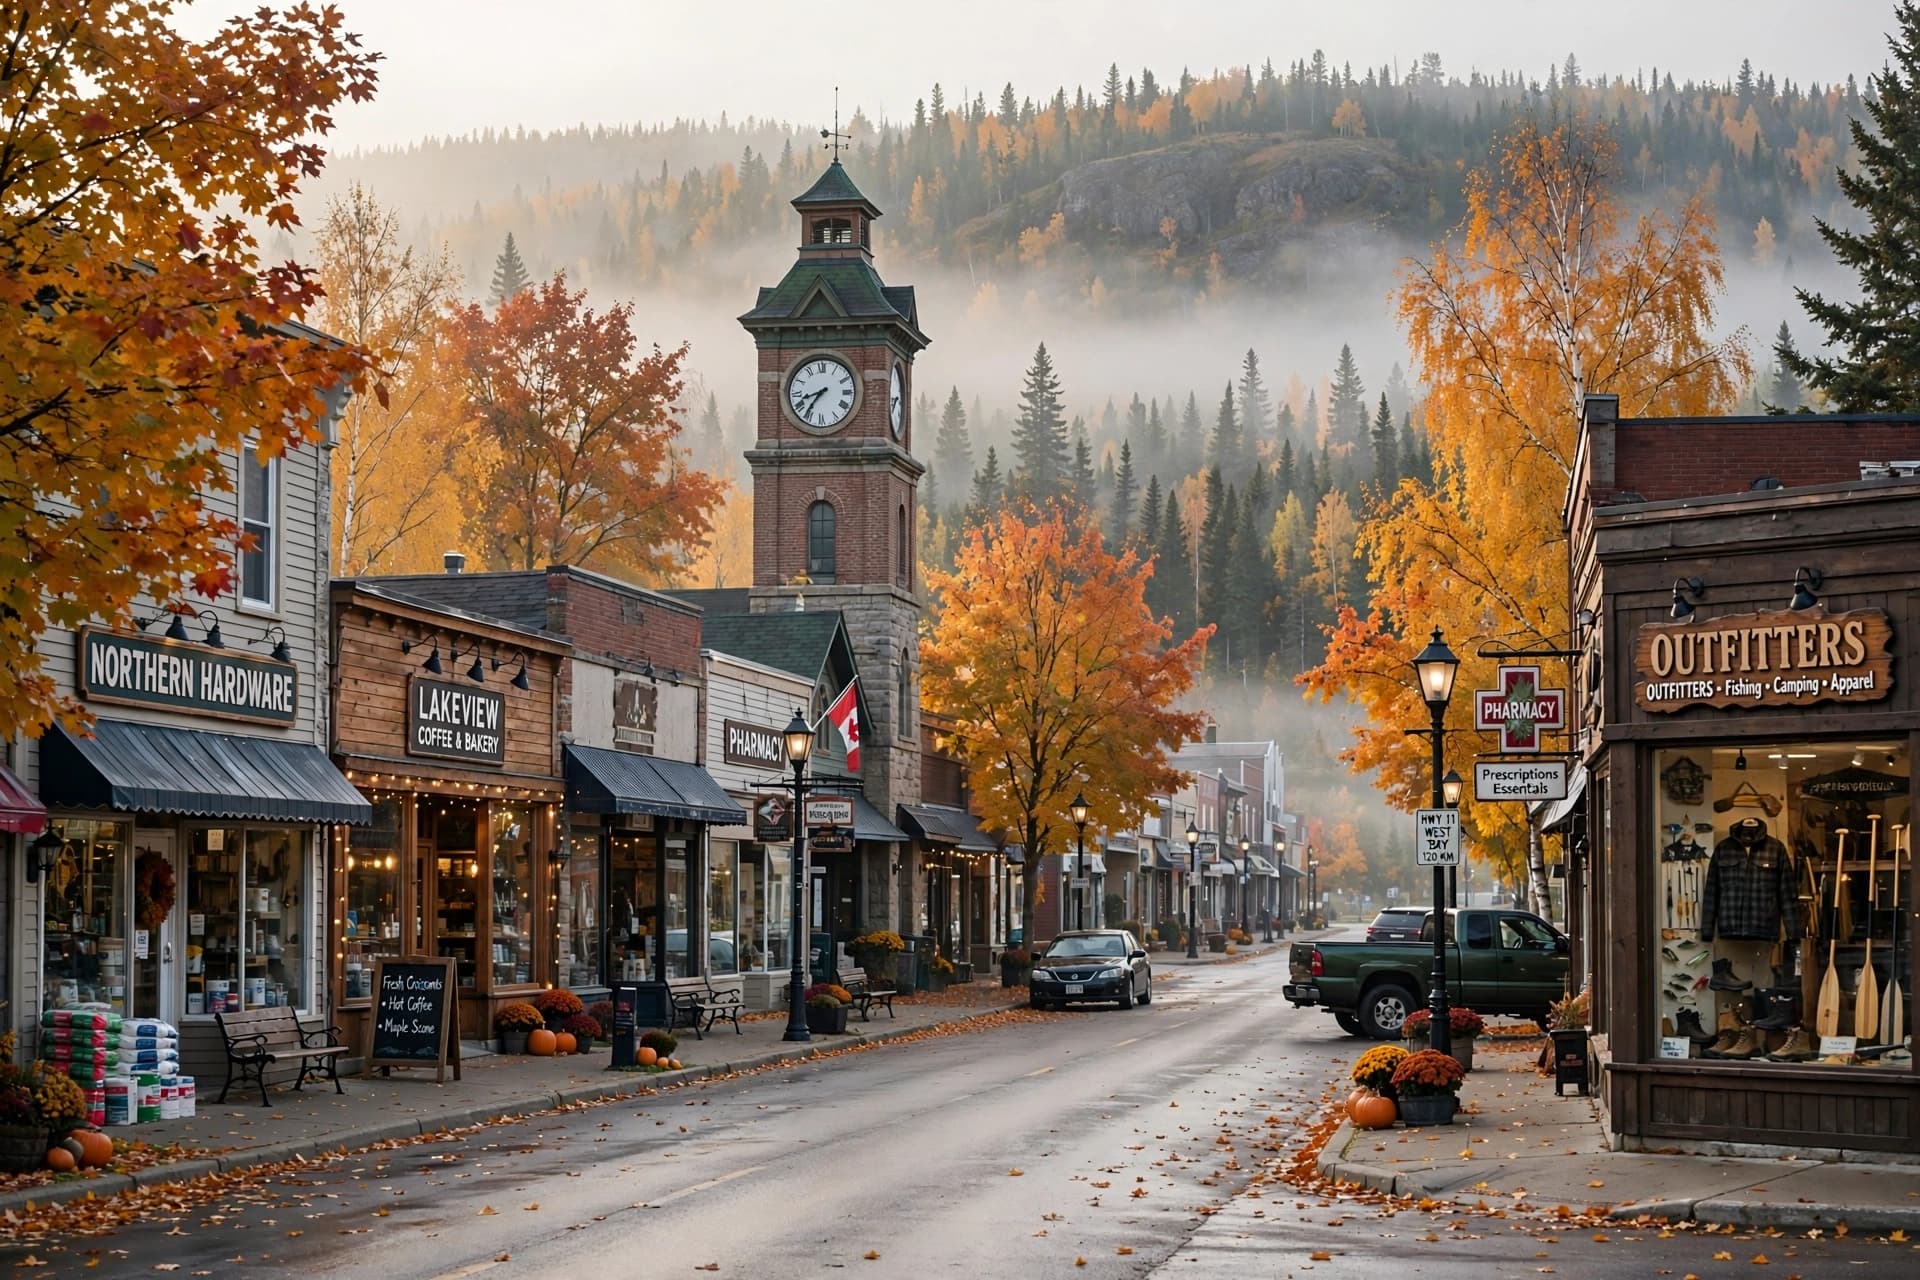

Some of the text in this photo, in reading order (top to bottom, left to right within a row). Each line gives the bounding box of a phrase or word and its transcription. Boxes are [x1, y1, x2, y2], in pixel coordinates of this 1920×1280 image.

[1650, 620, 1865, 677] OUTFITTERS
[91, 642, 293, 713] NORTHERN HARDWARE
[1646, 670, 1874, 700] OUTFITTERS Fishing Camping Apparel
[419, 686, 499, 730] LAKEVIEW
[1484, 701, 1556, 720] PHARMACY
[418, 726, 499, 754] COFFEE & BAKERY
[730, 727, 784, 762] PHARMACY
[1482, 768, 1559, 784] Prescriptions
[1421, 814, 1455, 824] HWY 11
[1425, 826, 1451, 838] WEST
[388, 995, 433, 1013] Hot Coffee
